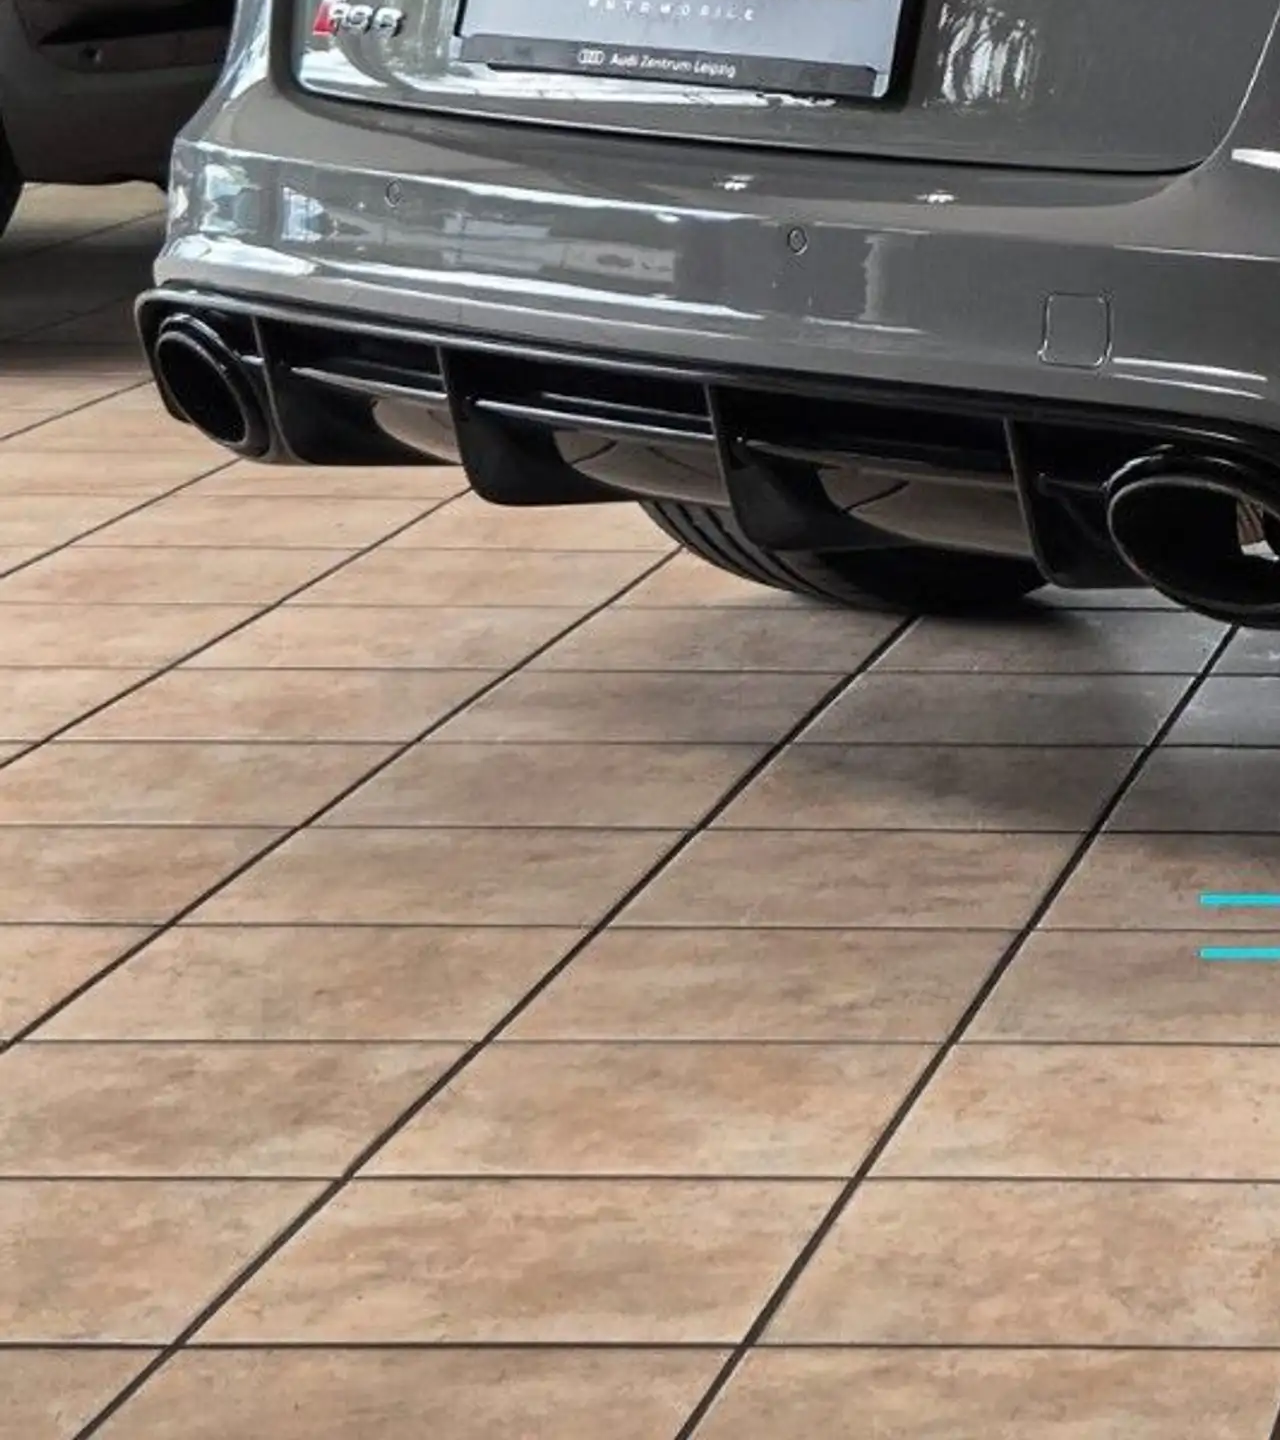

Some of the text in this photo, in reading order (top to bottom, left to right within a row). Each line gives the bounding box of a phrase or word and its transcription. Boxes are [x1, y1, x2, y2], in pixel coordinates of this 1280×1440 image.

[608, 52, 737, 79] Audi Zentrum Leipzig
